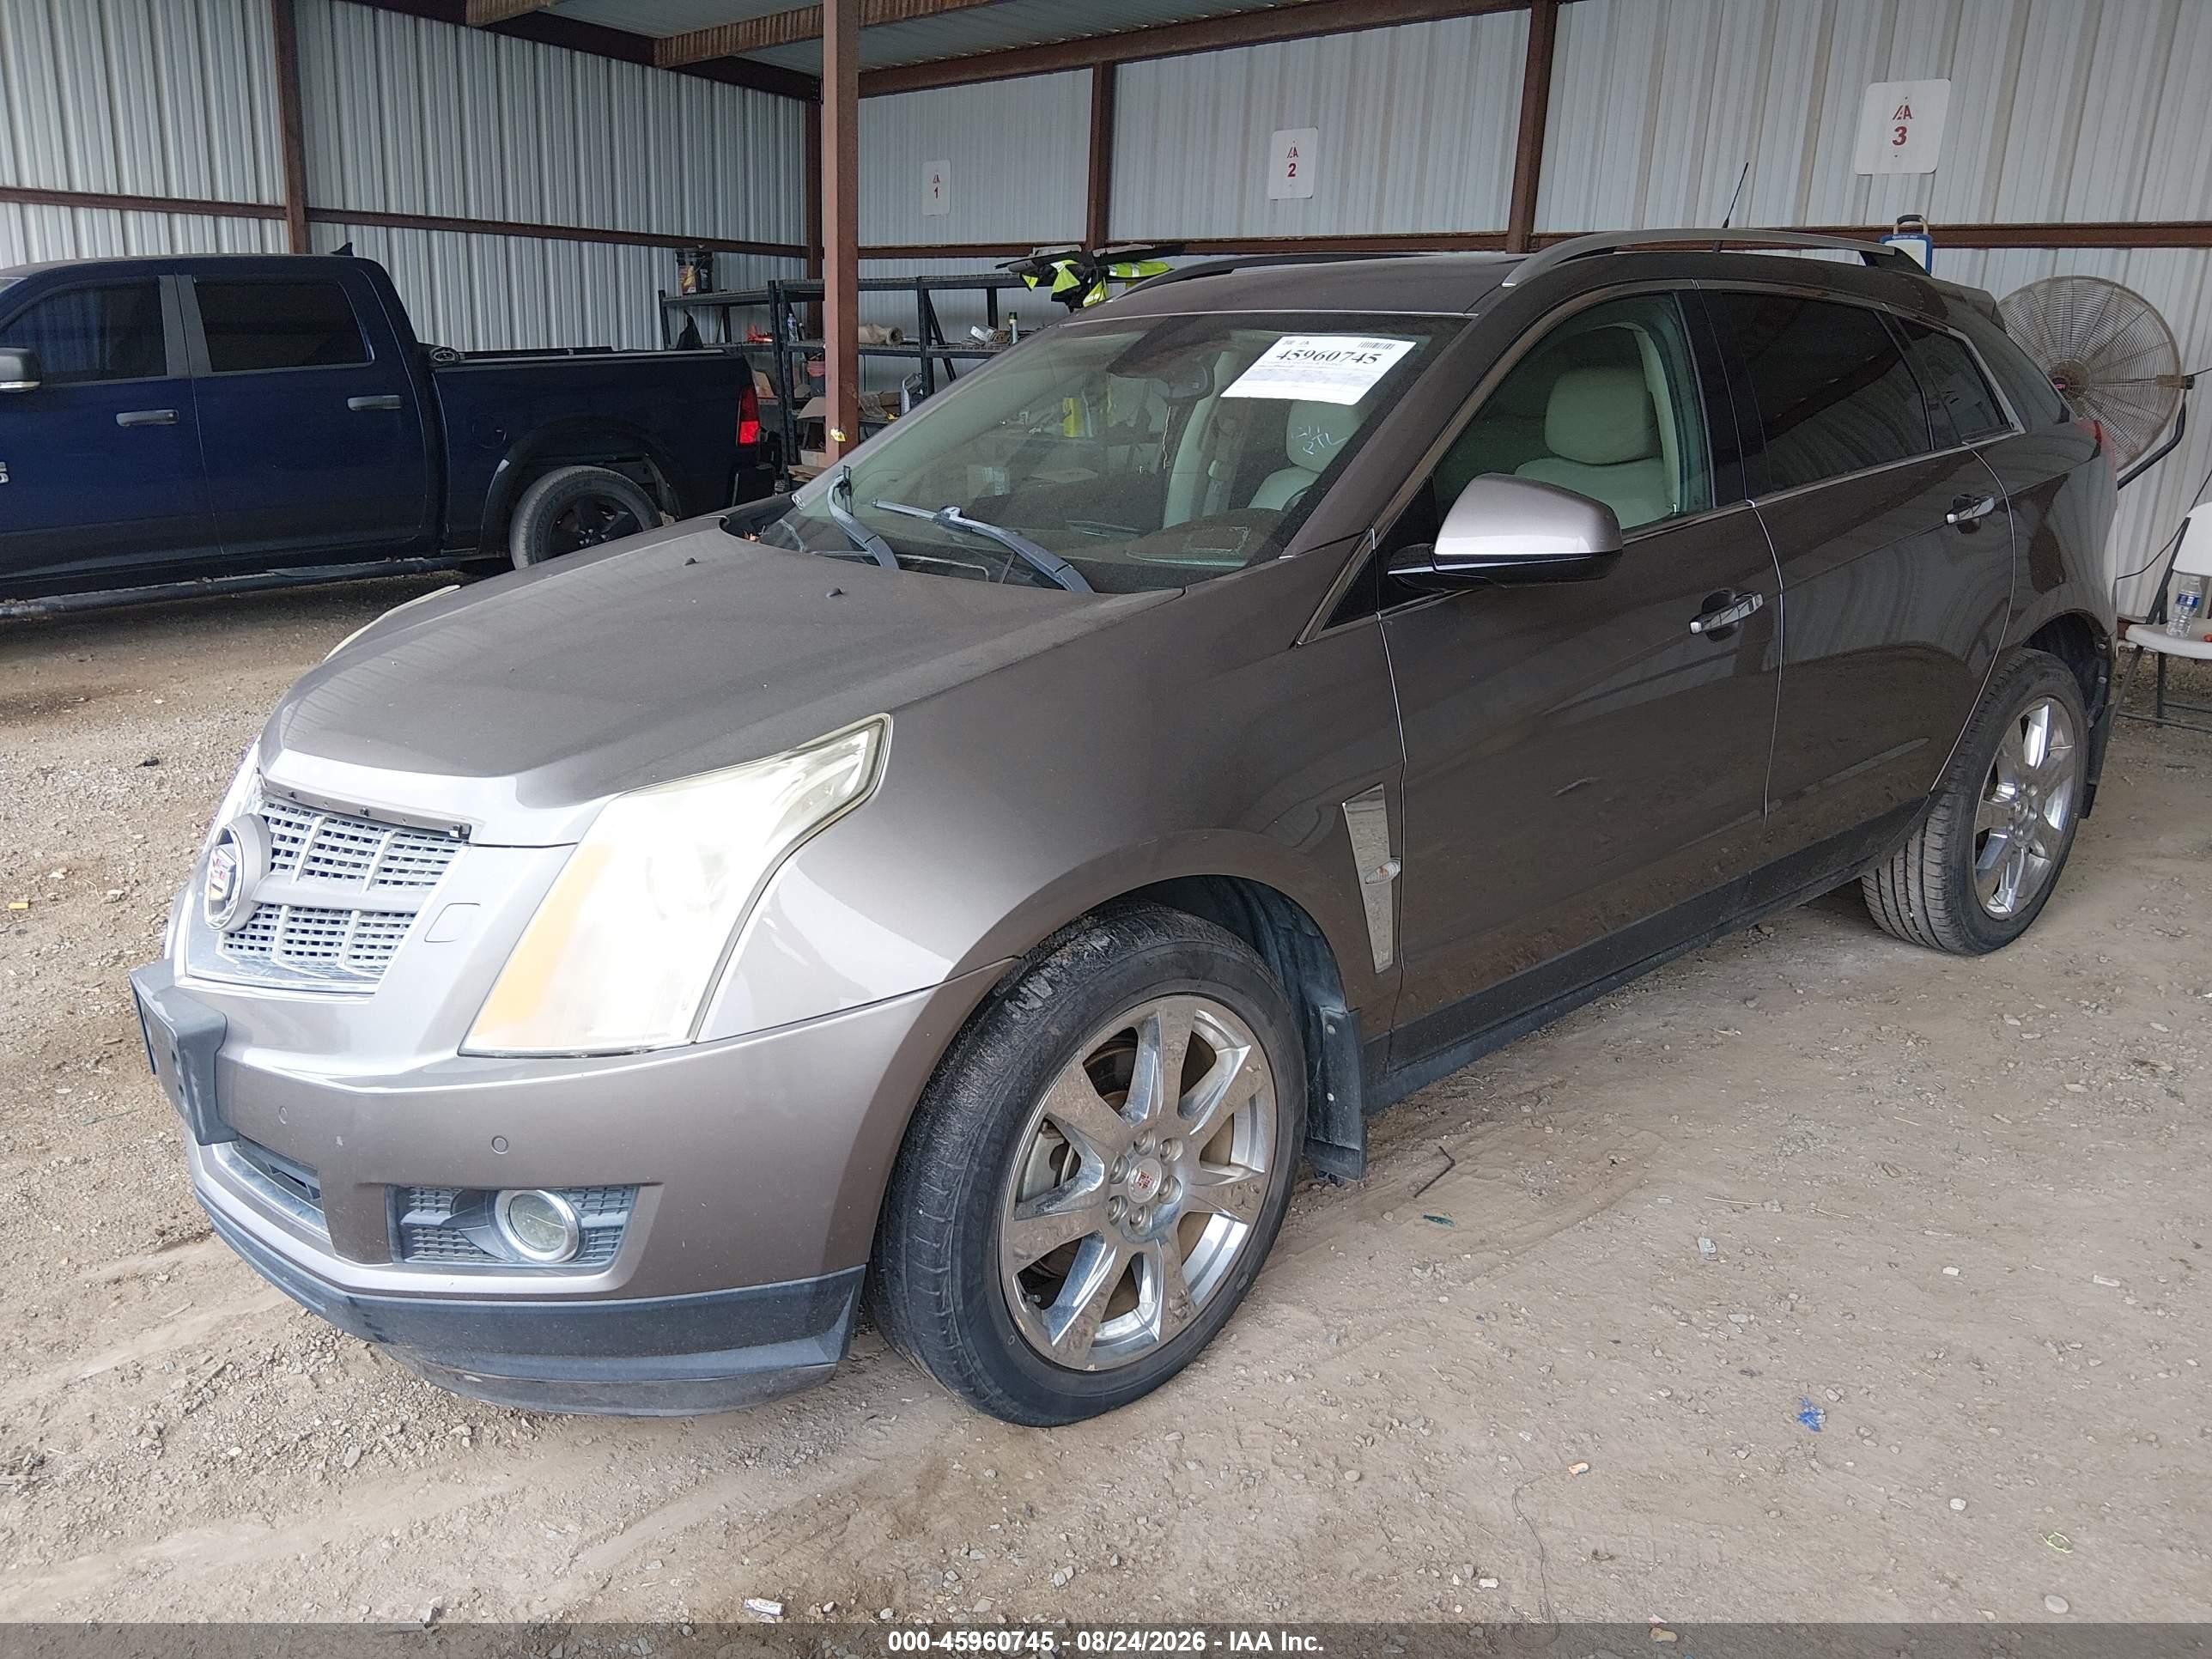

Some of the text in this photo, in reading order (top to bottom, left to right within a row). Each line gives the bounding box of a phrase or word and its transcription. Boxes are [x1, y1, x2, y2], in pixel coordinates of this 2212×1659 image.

[1892, 125, 1907, 146] 3
[1287, 162, 1297, 178] 2
[933, 186, 939, 199] 1
[1276, 349, 1382, 364] 45960745
